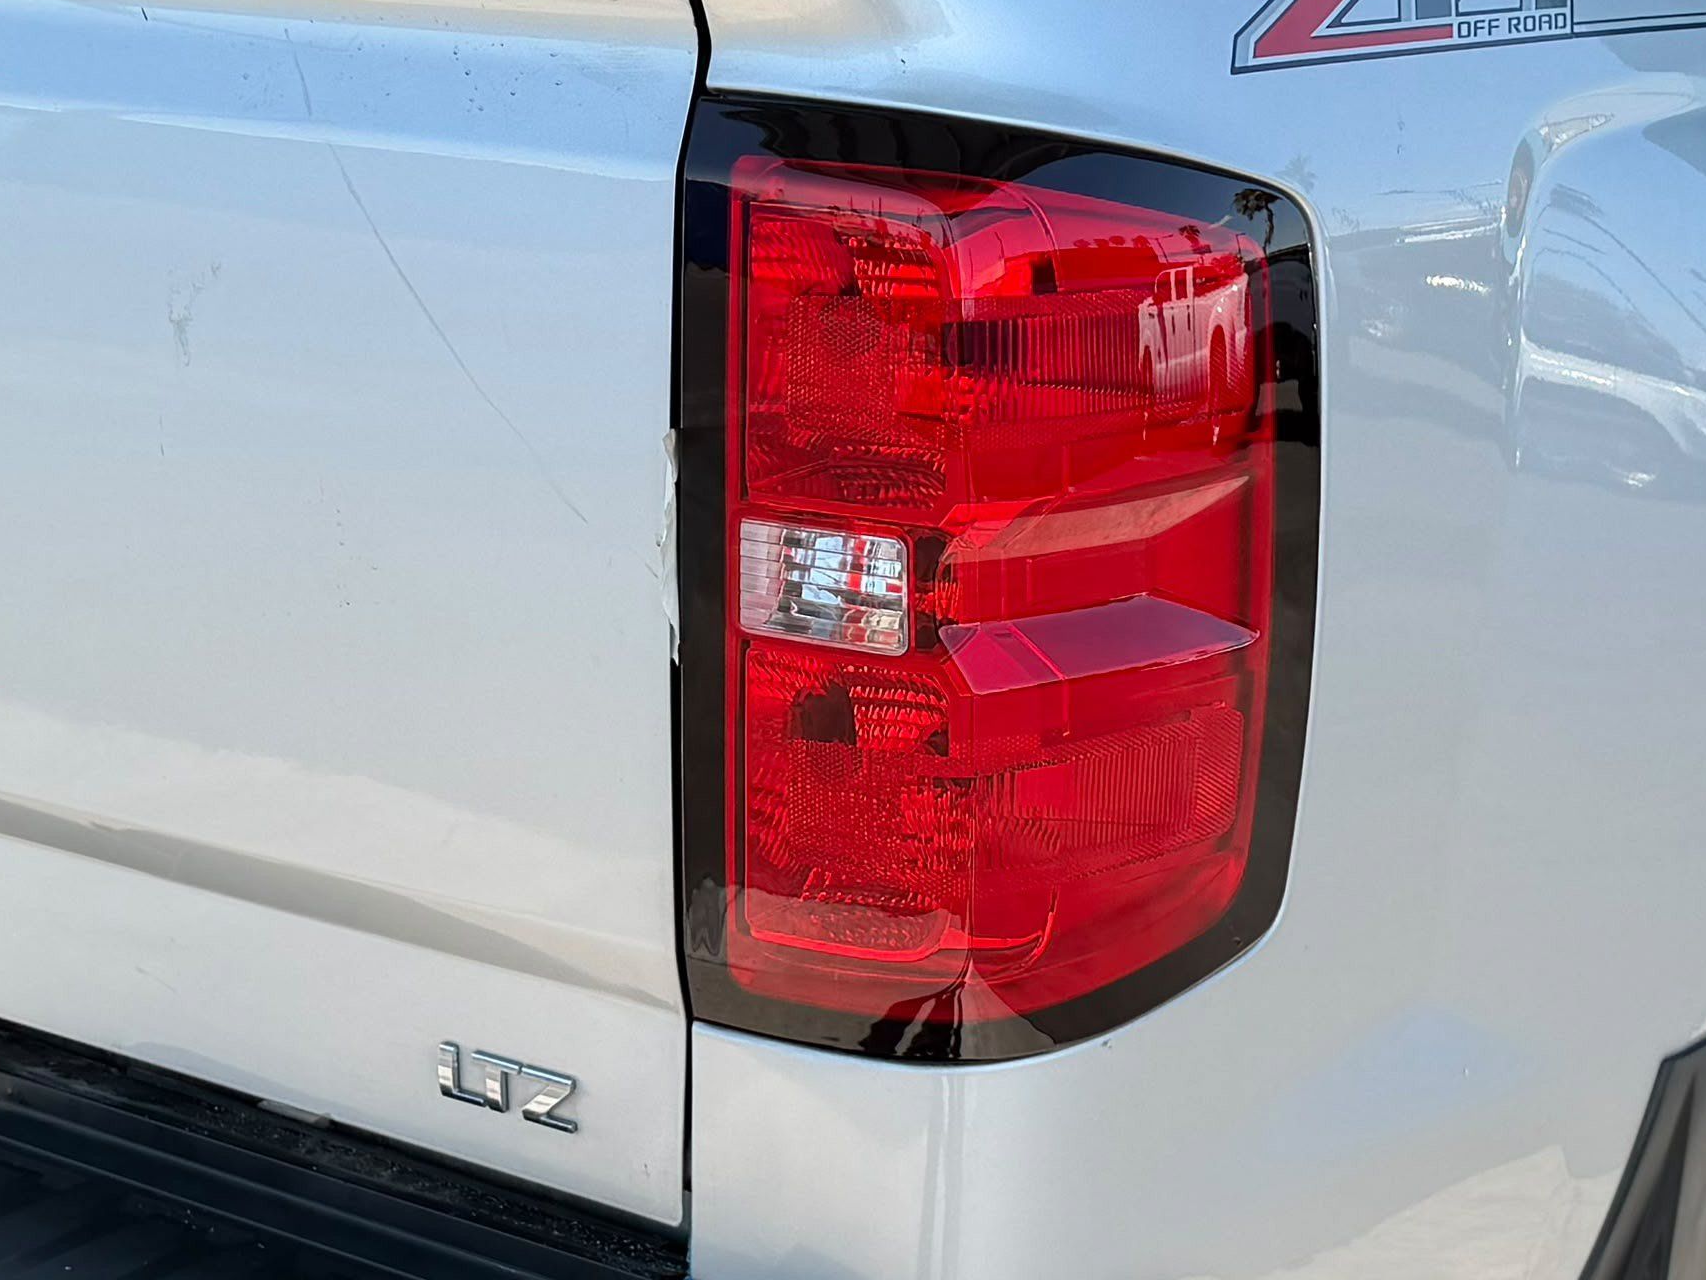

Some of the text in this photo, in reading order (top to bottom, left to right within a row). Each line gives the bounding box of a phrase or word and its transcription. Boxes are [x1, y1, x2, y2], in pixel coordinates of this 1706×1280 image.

[1457, 12, 1568, 39] OFF ROAD
[437, 1040, 578, 1134] LTZ
